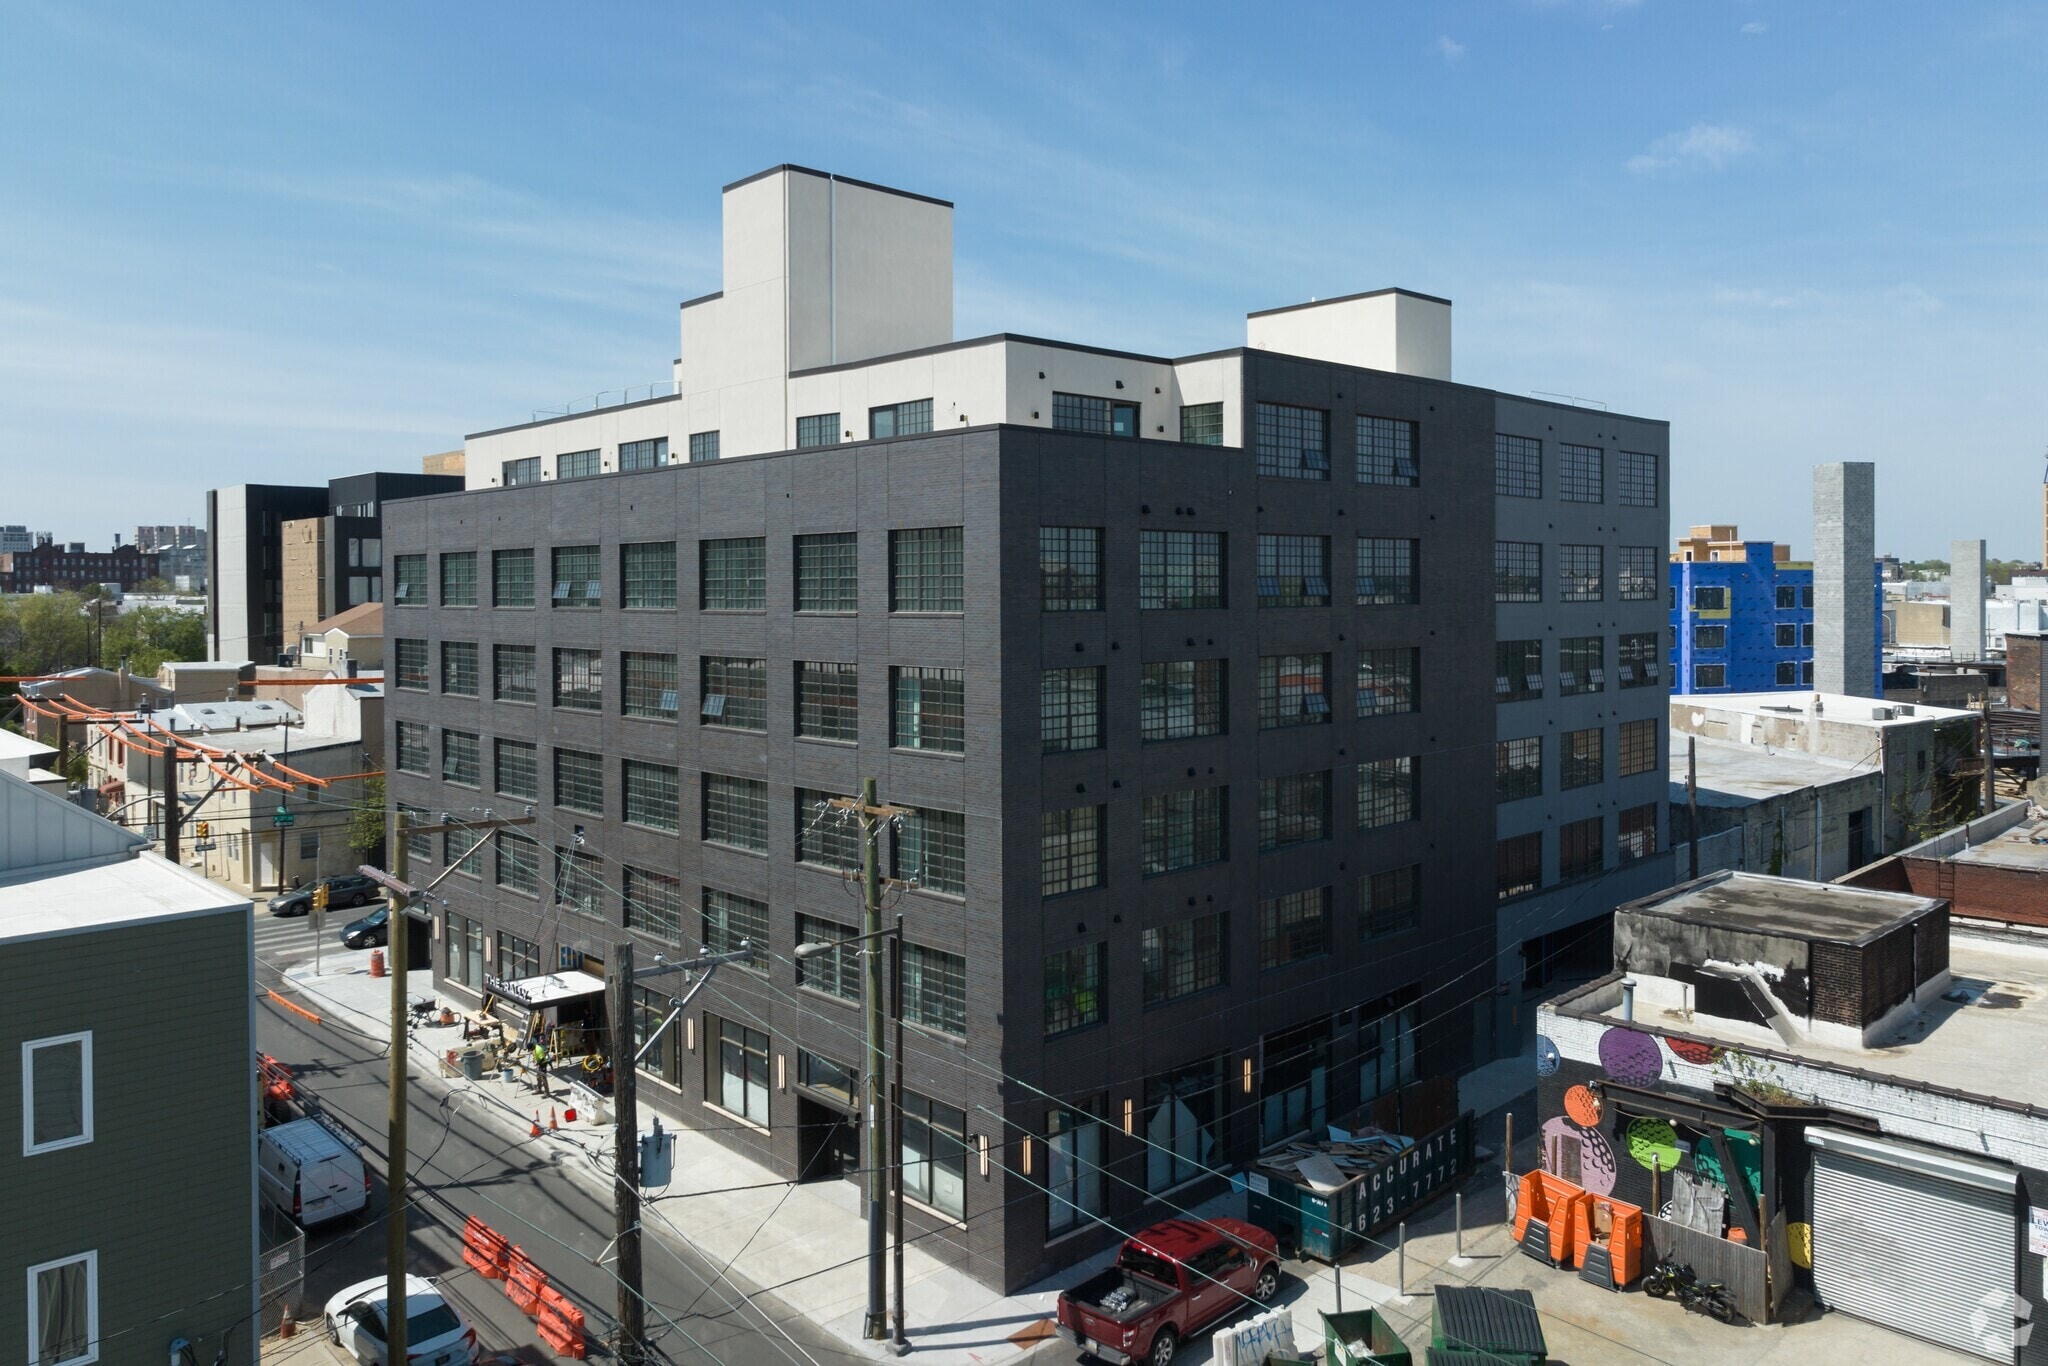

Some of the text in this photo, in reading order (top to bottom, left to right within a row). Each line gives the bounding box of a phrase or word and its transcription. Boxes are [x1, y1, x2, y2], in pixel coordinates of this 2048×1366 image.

[485, 972, 500, 988] THE
[1358, 1158, 1457, 1231] 623-7772
[1359, 1128, 1456, 1200] ACCURATE
